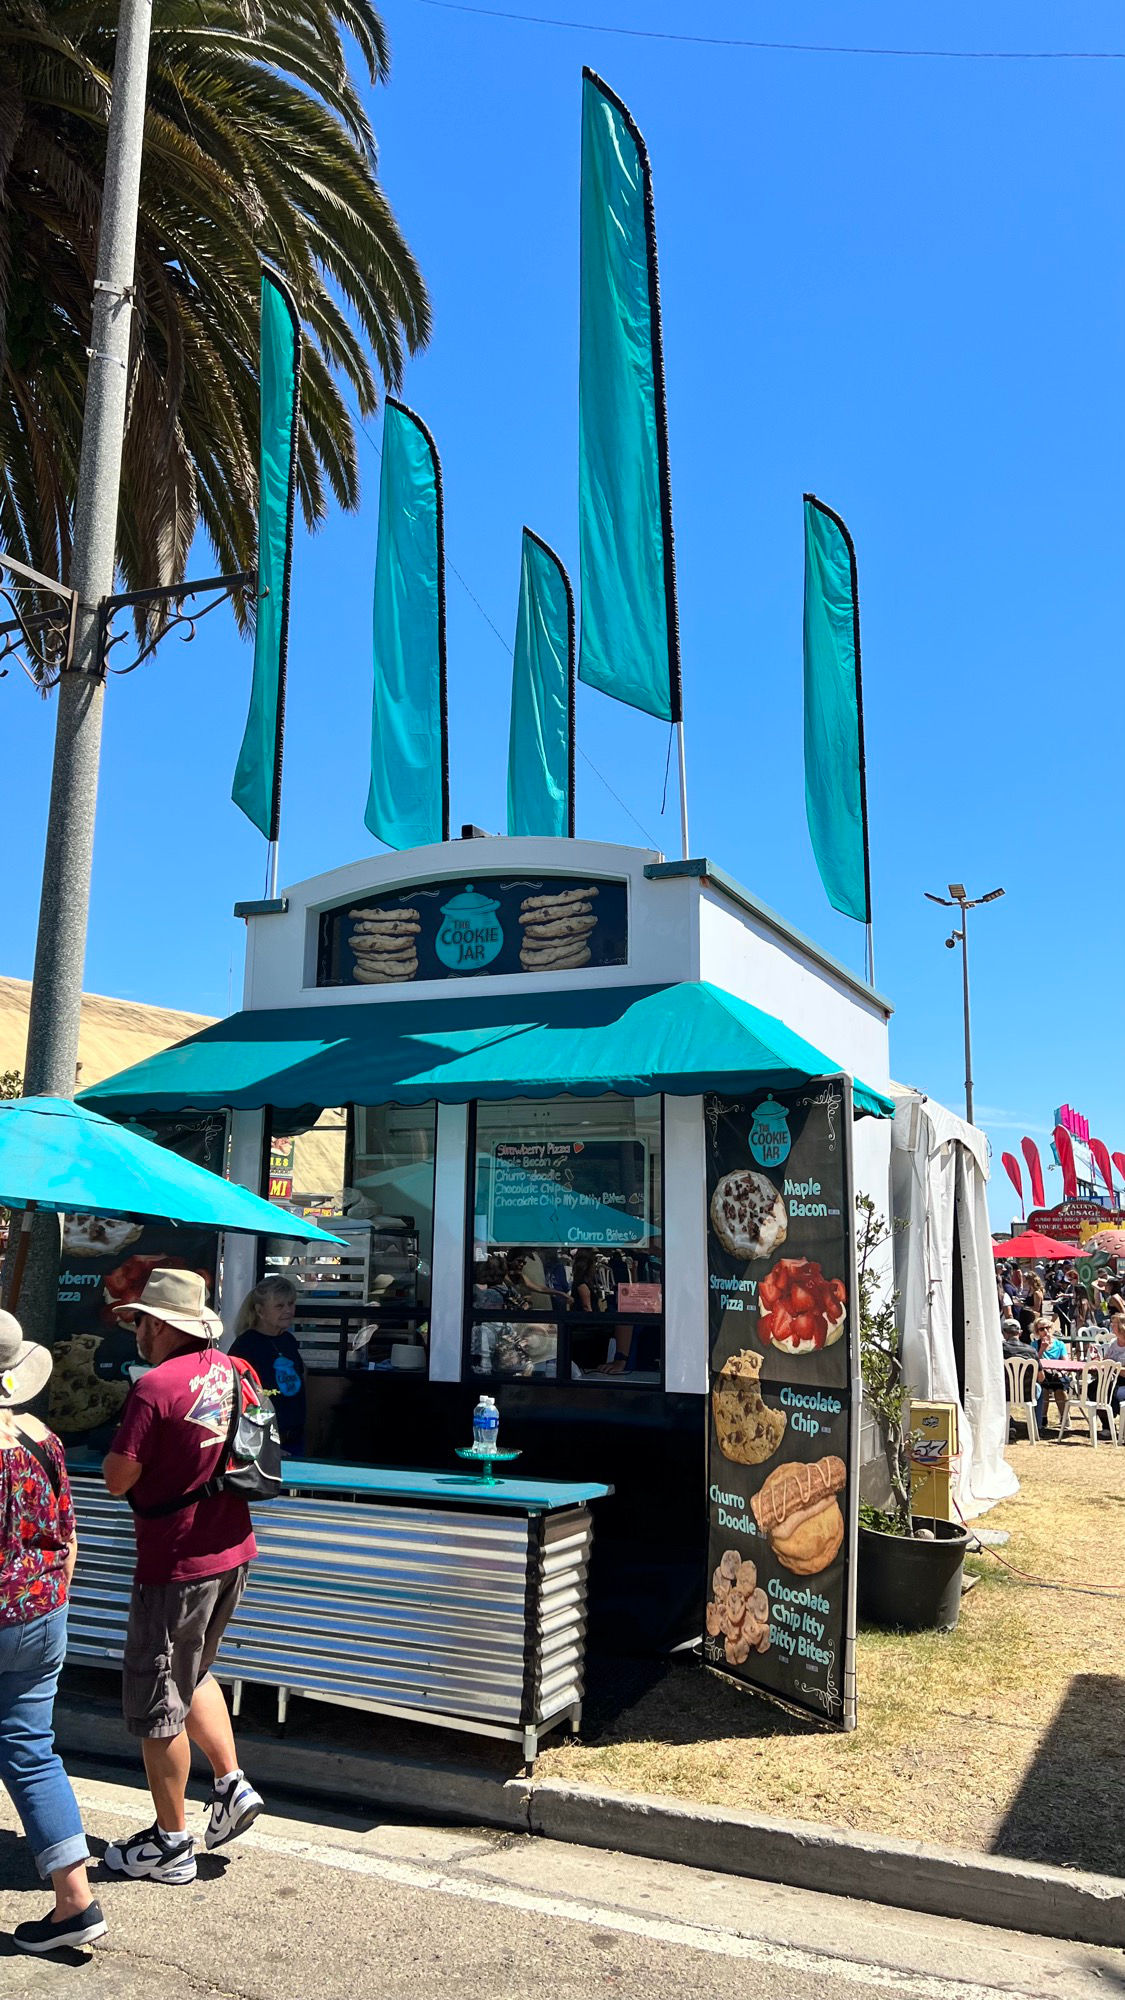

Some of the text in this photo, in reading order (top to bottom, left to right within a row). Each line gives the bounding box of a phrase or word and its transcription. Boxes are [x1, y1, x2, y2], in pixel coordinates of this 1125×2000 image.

[454, 920, 471, 929] THE
[441, 927, 498, 945] COOKIE
[458, 944, 485, 964] JAR
[751, 1131, 788, 1146] COOKIE
[497, 1142, 571, 1158] Strawberry Pizza
[762, 1146, 780, 1162] JAR
[522, 1156, 552, 1168] Bacon
[495, 1182, 560, 1197] Chocolate Chip
[784, 1177, 821, 1199] Maple
[495, 1195, 539, 1207] Chocolate
[540, 1194, 562, 1210] Chip
[602, 1192, 627, 1205] Bites
[789, 1200, 828, 1217] Bacon
[567, 1226, 604, 1242] Churro
[606, 1228, 628, 1242] Bites
[710, 1274, 757, 1296] Strawberry
[720, 1294, 744, 1311] Pizza
[780, 1387, 842, 1414] Chocolate
[790, 1412, 820, 1437] Chip
[709, 1484, 745, 1510] Churro
[718, 1508, 757, 1535] Doodle
[767, 1578, 830, 1615] Chocolate
[771, 1603, 825, 1641] Chip Itty
[768, 1623, 830, 1665] Bitty Bites
